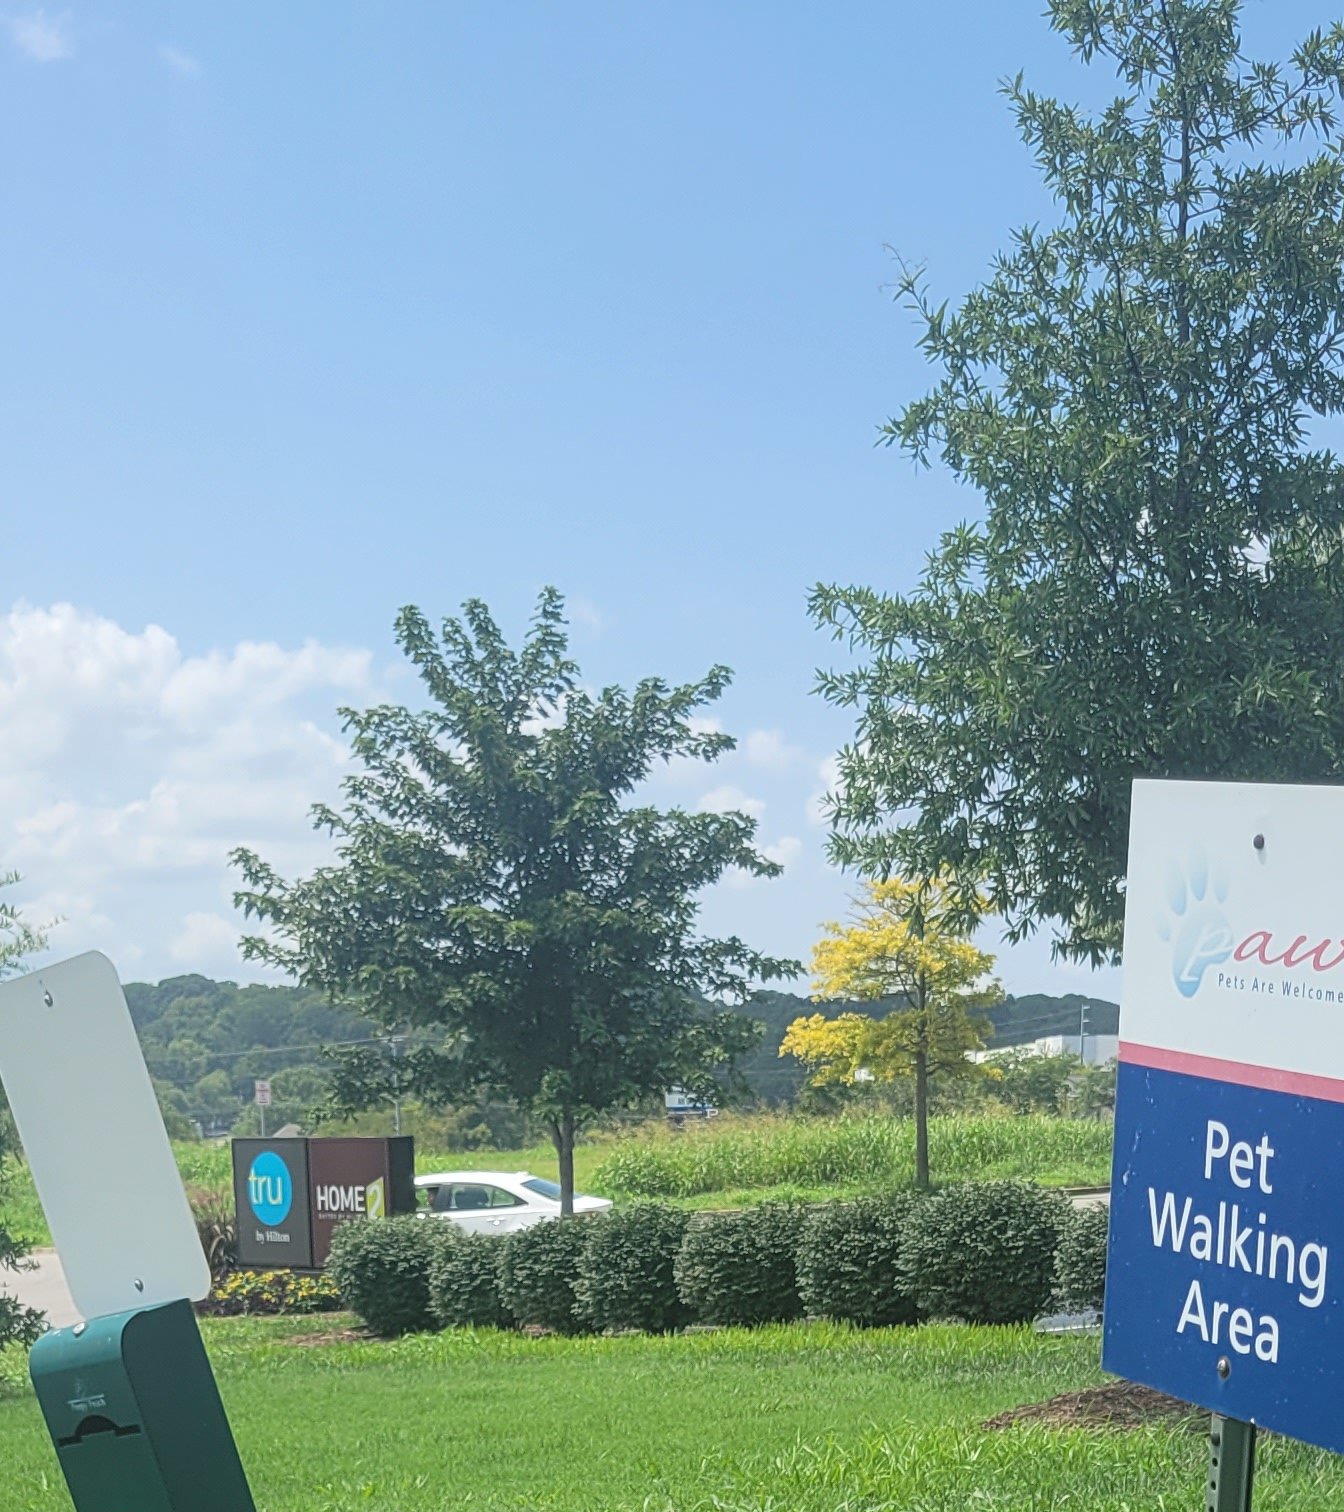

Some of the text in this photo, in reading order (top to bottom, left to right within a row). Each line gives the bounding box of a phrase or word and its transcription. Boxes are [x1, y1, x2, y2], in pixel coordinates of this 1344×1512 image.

[1218, 972, 1344, 1003] Pets Are Welcome
[1203, 1119, 1275, 1195] Pet
[248, 1167, 283, 1206] tru
[255, 1229, 291, 1245] by Hilton
[1147, 1186, 1329, 1309] Walking
[1176, 1279, 1280, 1364] Area
